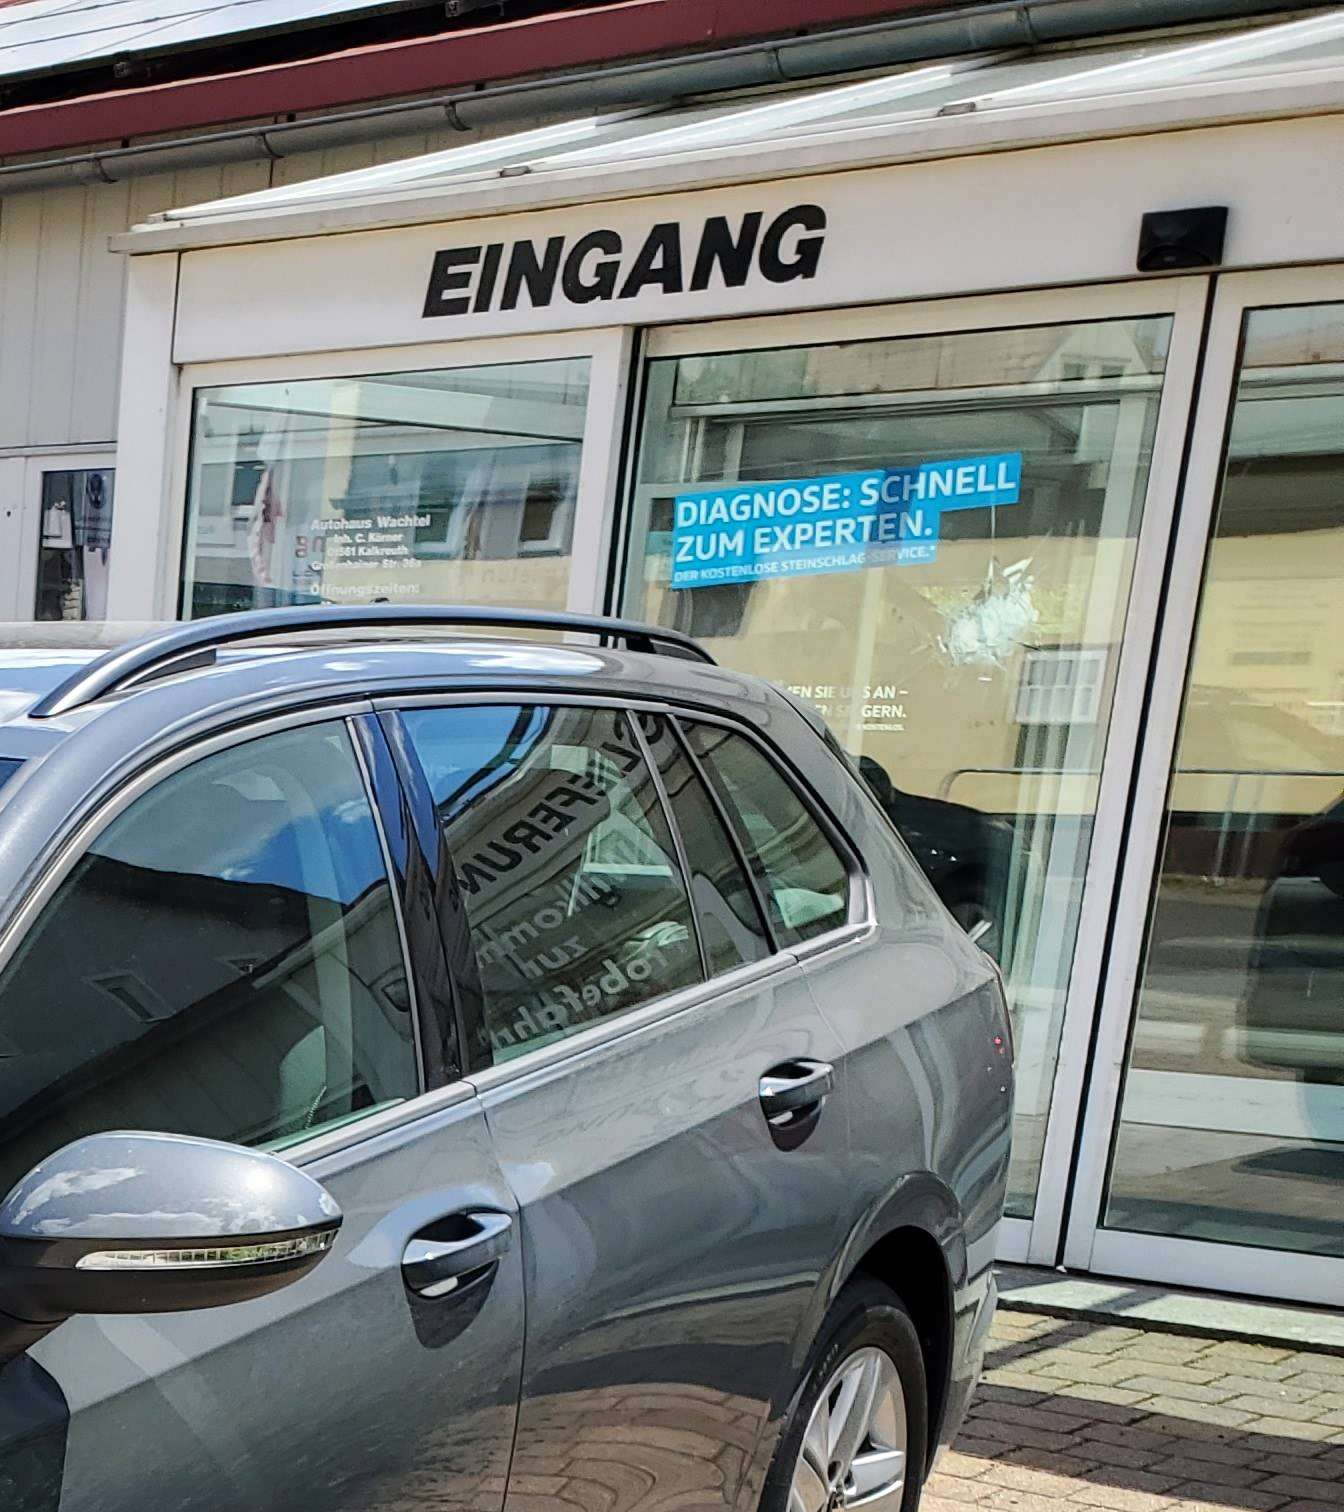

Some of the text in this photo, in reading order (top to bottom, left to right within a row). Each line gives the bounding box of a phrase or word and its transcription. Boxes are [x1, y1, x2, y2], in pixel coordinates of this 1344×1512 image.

[422, 204, 827, 318] EINGANG
[676, 461, 1017, 529] DIAGNOSE: SCHNELL
[311, 514, 432, 530] Autohaus Wachtel
[676, 508, 934, 563] ZUM EXPERTEN.
[673, 570, 699, 583] DER
[700, 561, 779, 580] KOSTENLOSE
[861, 704, 908, 719] GERN.
